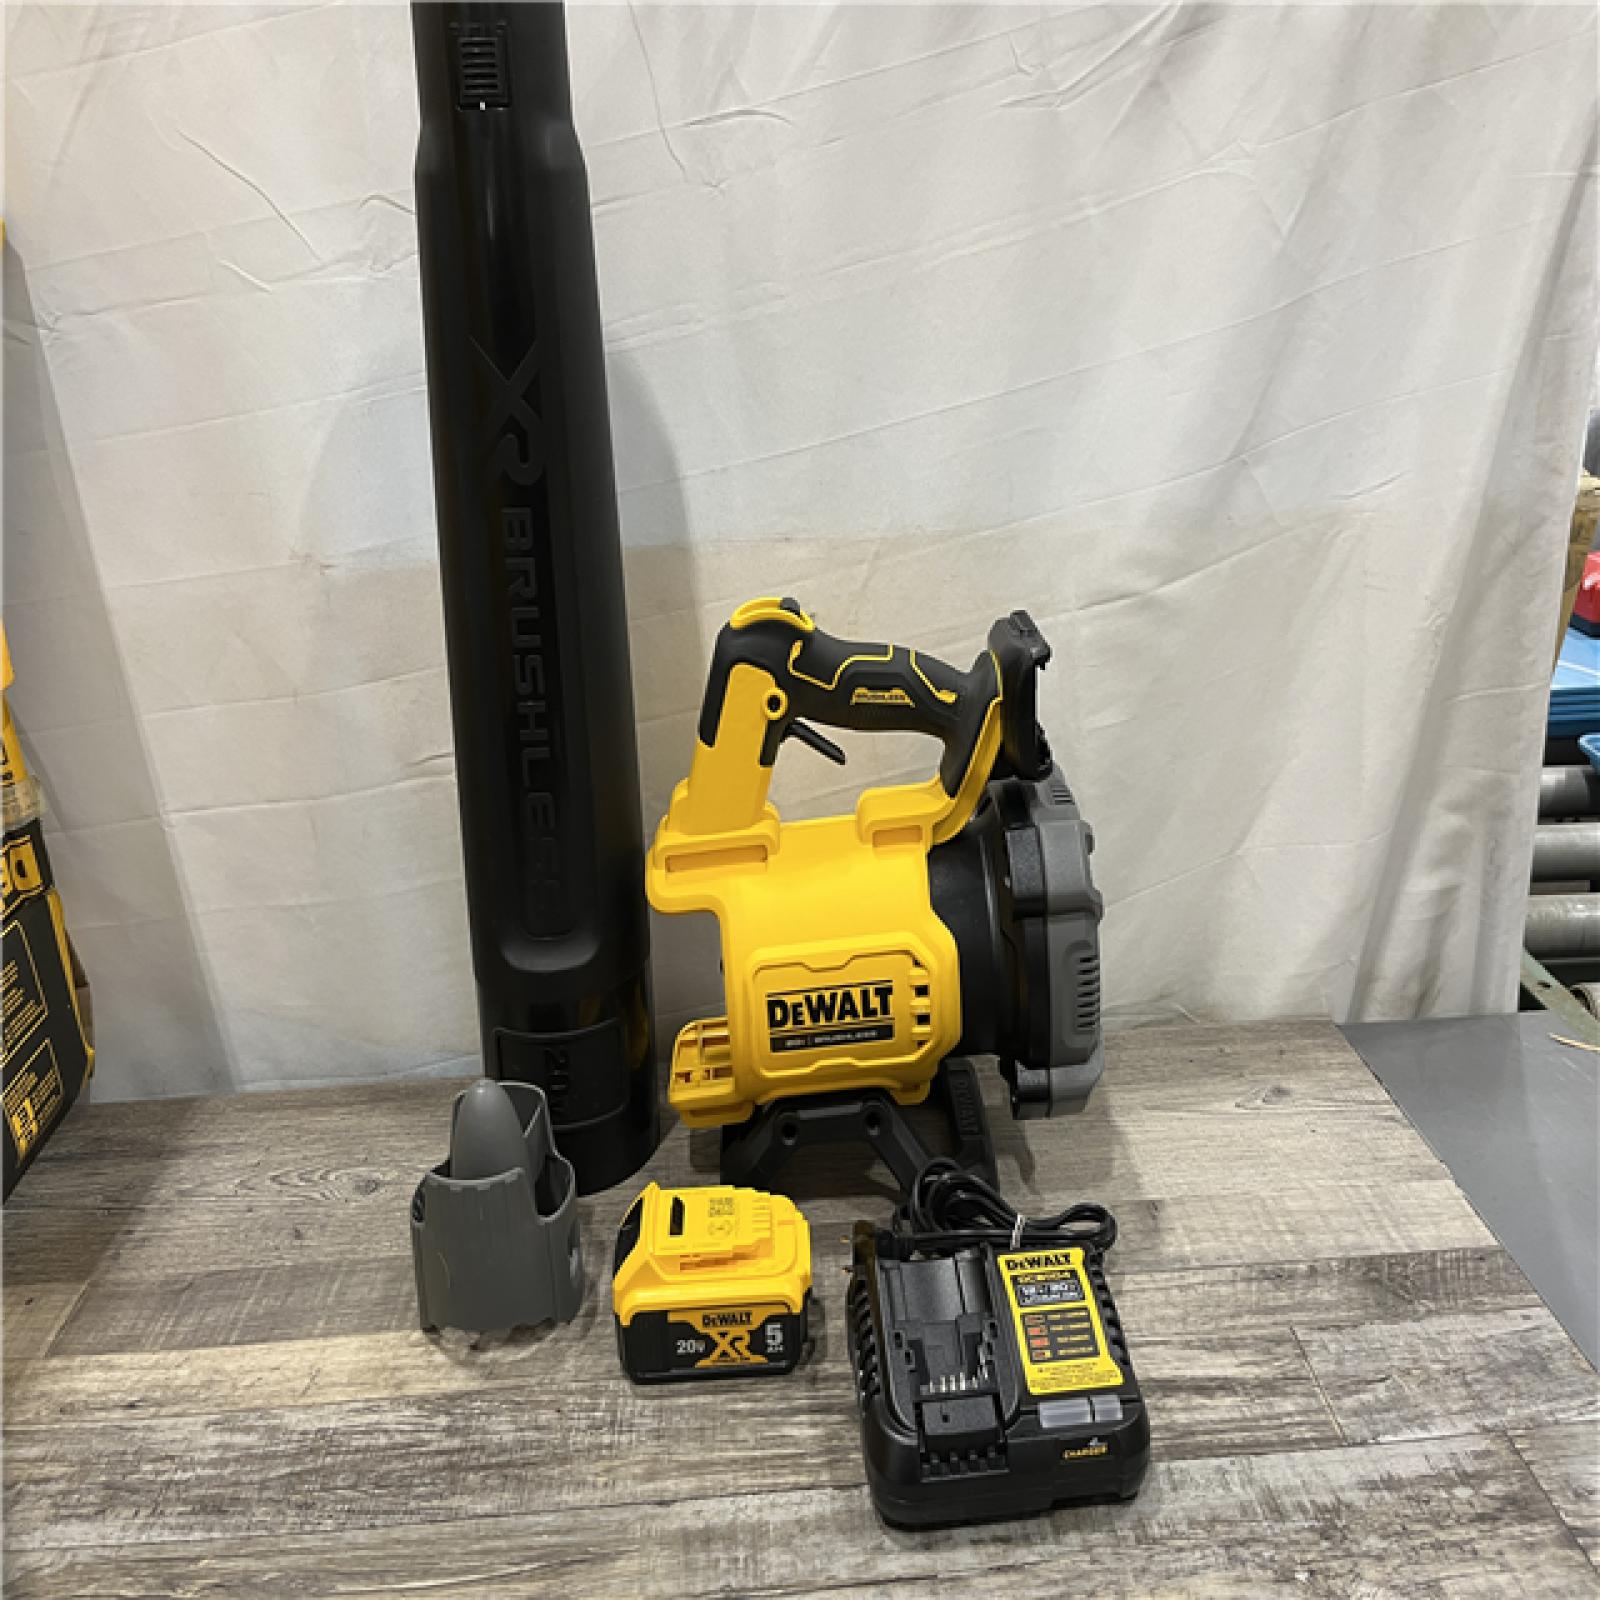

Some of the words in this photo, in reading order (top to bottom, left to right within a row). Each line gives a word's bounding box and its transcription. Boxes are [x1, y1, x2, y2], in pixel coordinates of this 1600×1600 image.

[767, 986, 893, 1028] DEWALT
[1006, 1253, 1071, 1270] DEWALT
[702, 1312, 752, 1327] DEWALT
[766, 1323, 784, 1345] 5
